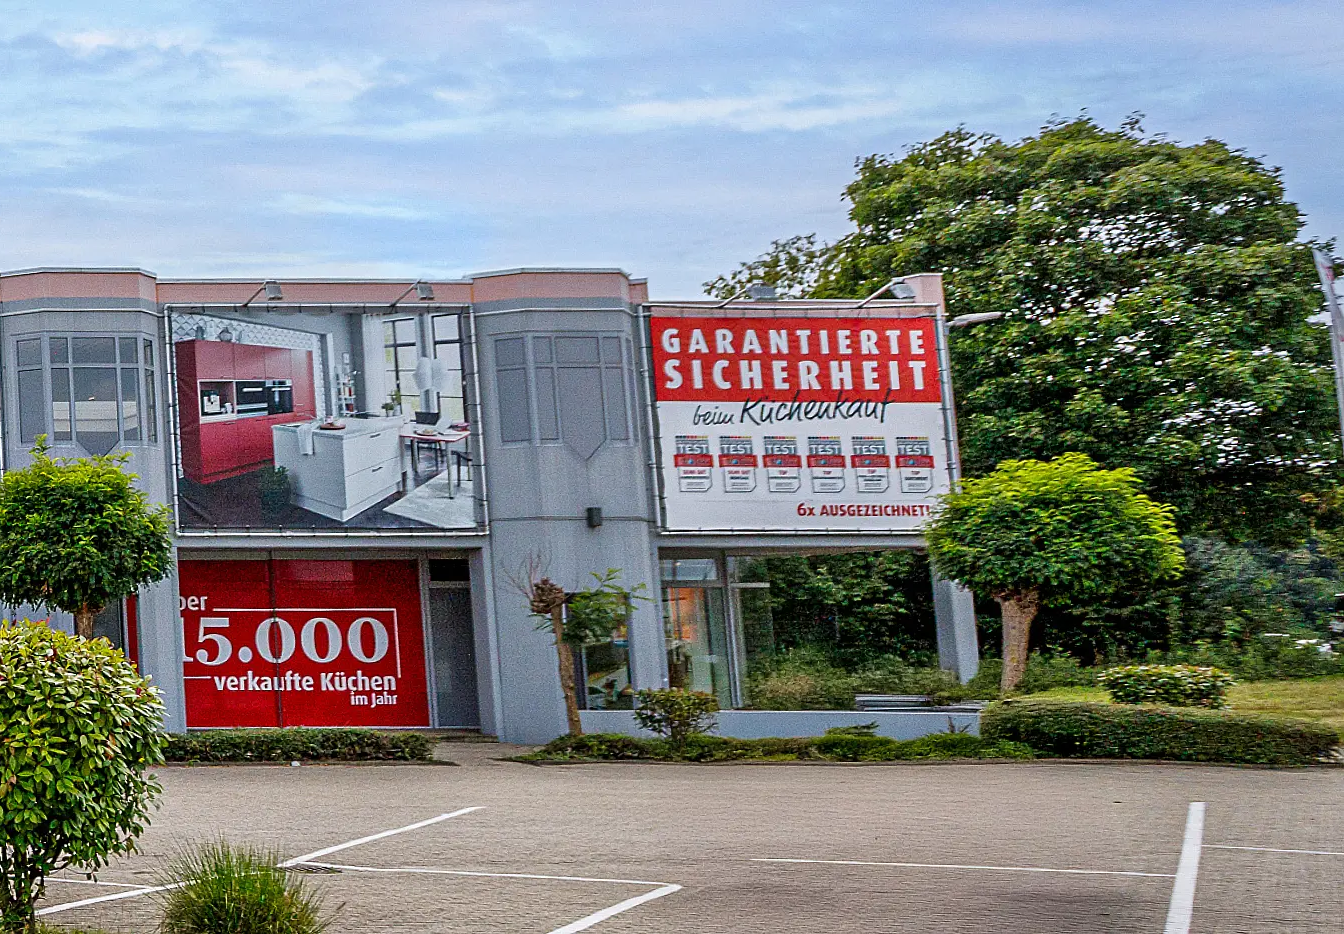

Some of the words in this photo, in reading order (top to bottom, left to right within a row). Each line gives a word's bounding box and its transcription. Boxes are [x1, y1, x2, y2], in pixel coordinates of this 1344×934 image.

[661, 328, 925, 355] GARANTIERTE
[663, 358, 927, 391] SICHERHEIT
[692, 404, 735, 426] beim
[677, 444, 709, 454] TEST
[721, 444, 753, 454] TEST
[765, 445, 798, 455] TEST
[808, 445, 841, 455] TEST
[853, 445, 885, 455] TEST
[898, 445, 929, 455] TEST
[797, 502, 816, 517] 6x
[819, 503, 931, 517] AUSGEZEICHNET!
[181, 616, 389, 666] 5.000
[214, 670, 314, 691] verkaufte
[321, 670, 397, 691] Küchen
[350, 691, 368, 705] im
[371, 691, 398, 708] Jahr
